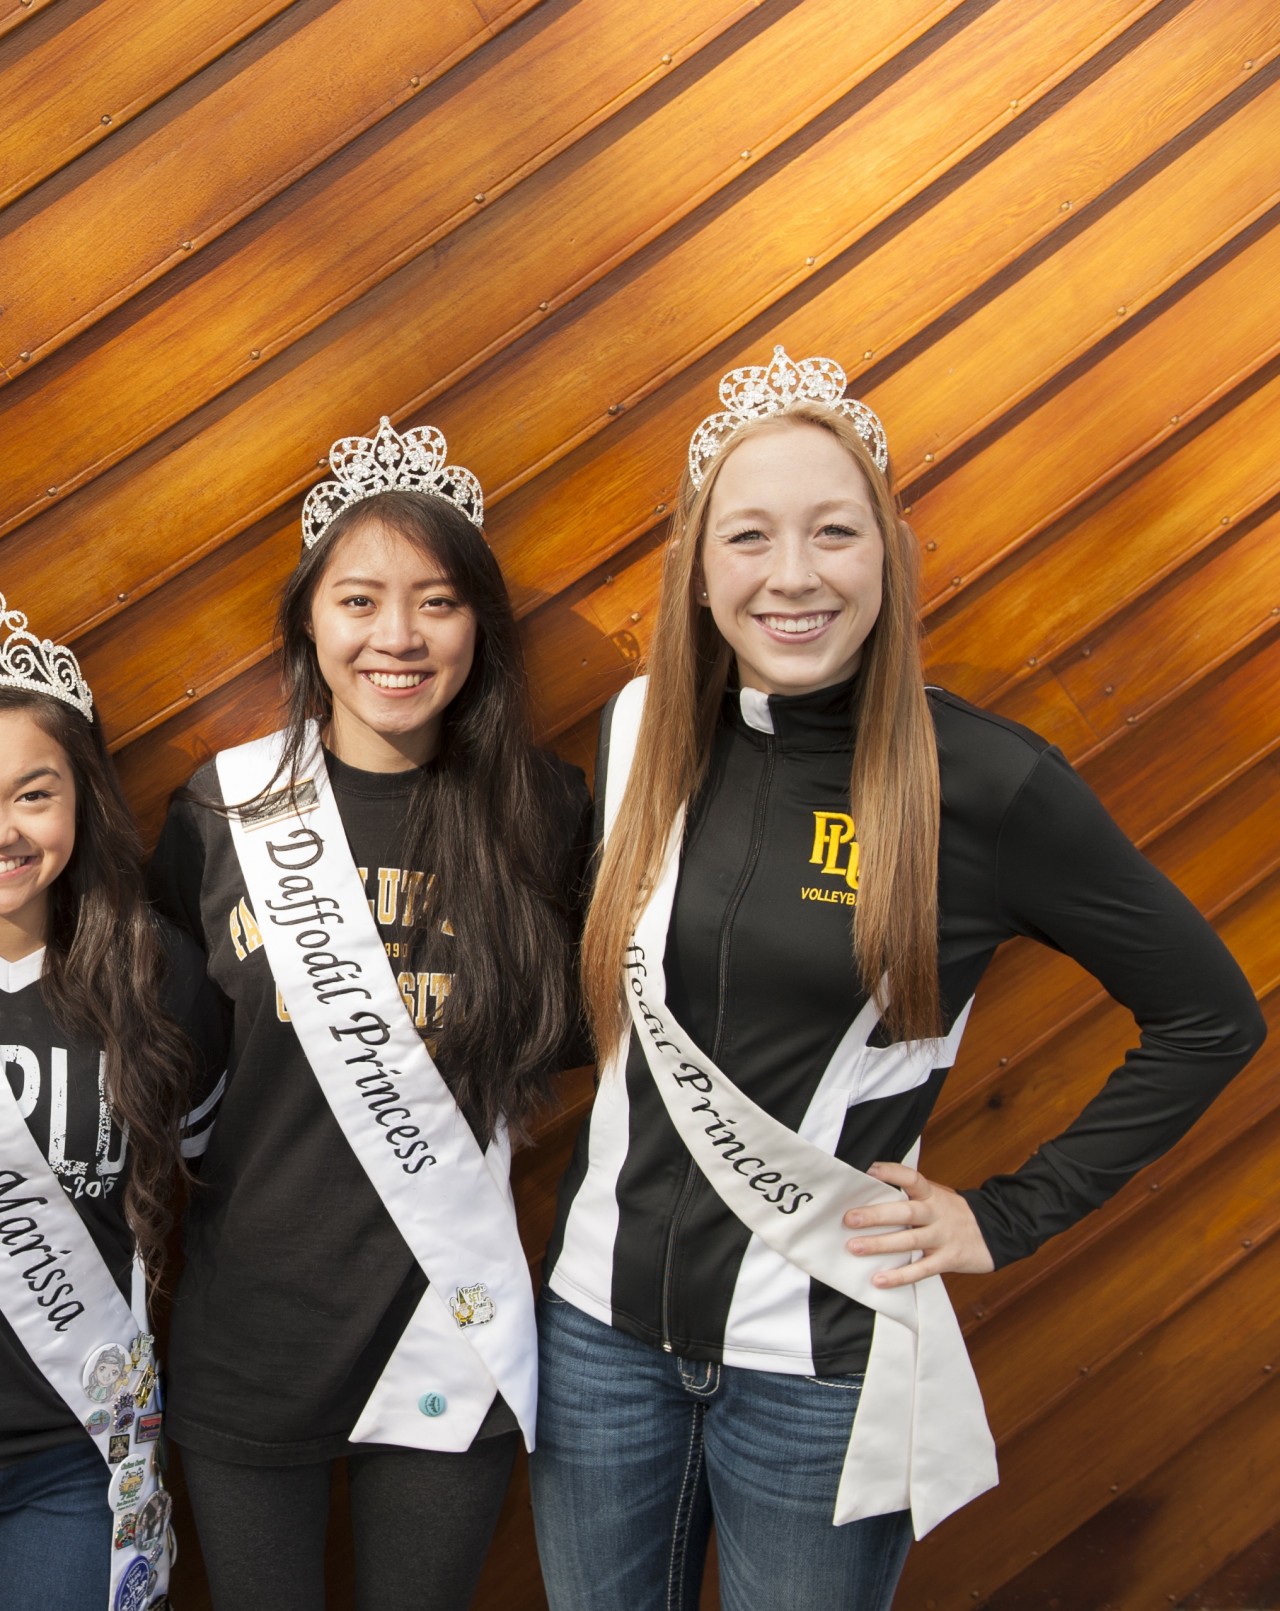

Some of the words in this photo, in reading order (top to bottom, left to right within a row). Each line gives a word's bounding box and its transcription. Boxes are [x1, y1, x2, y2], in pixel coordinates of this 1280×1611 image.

[265, 828, 371, 1005] Daffodil
[329, 1011, 437, 1175] Princess
[801, 887, 858, 906] VOLLEYB
[622, 936, 682, 1054] ffodil
[673, 1062, 814, 1215] Princess
